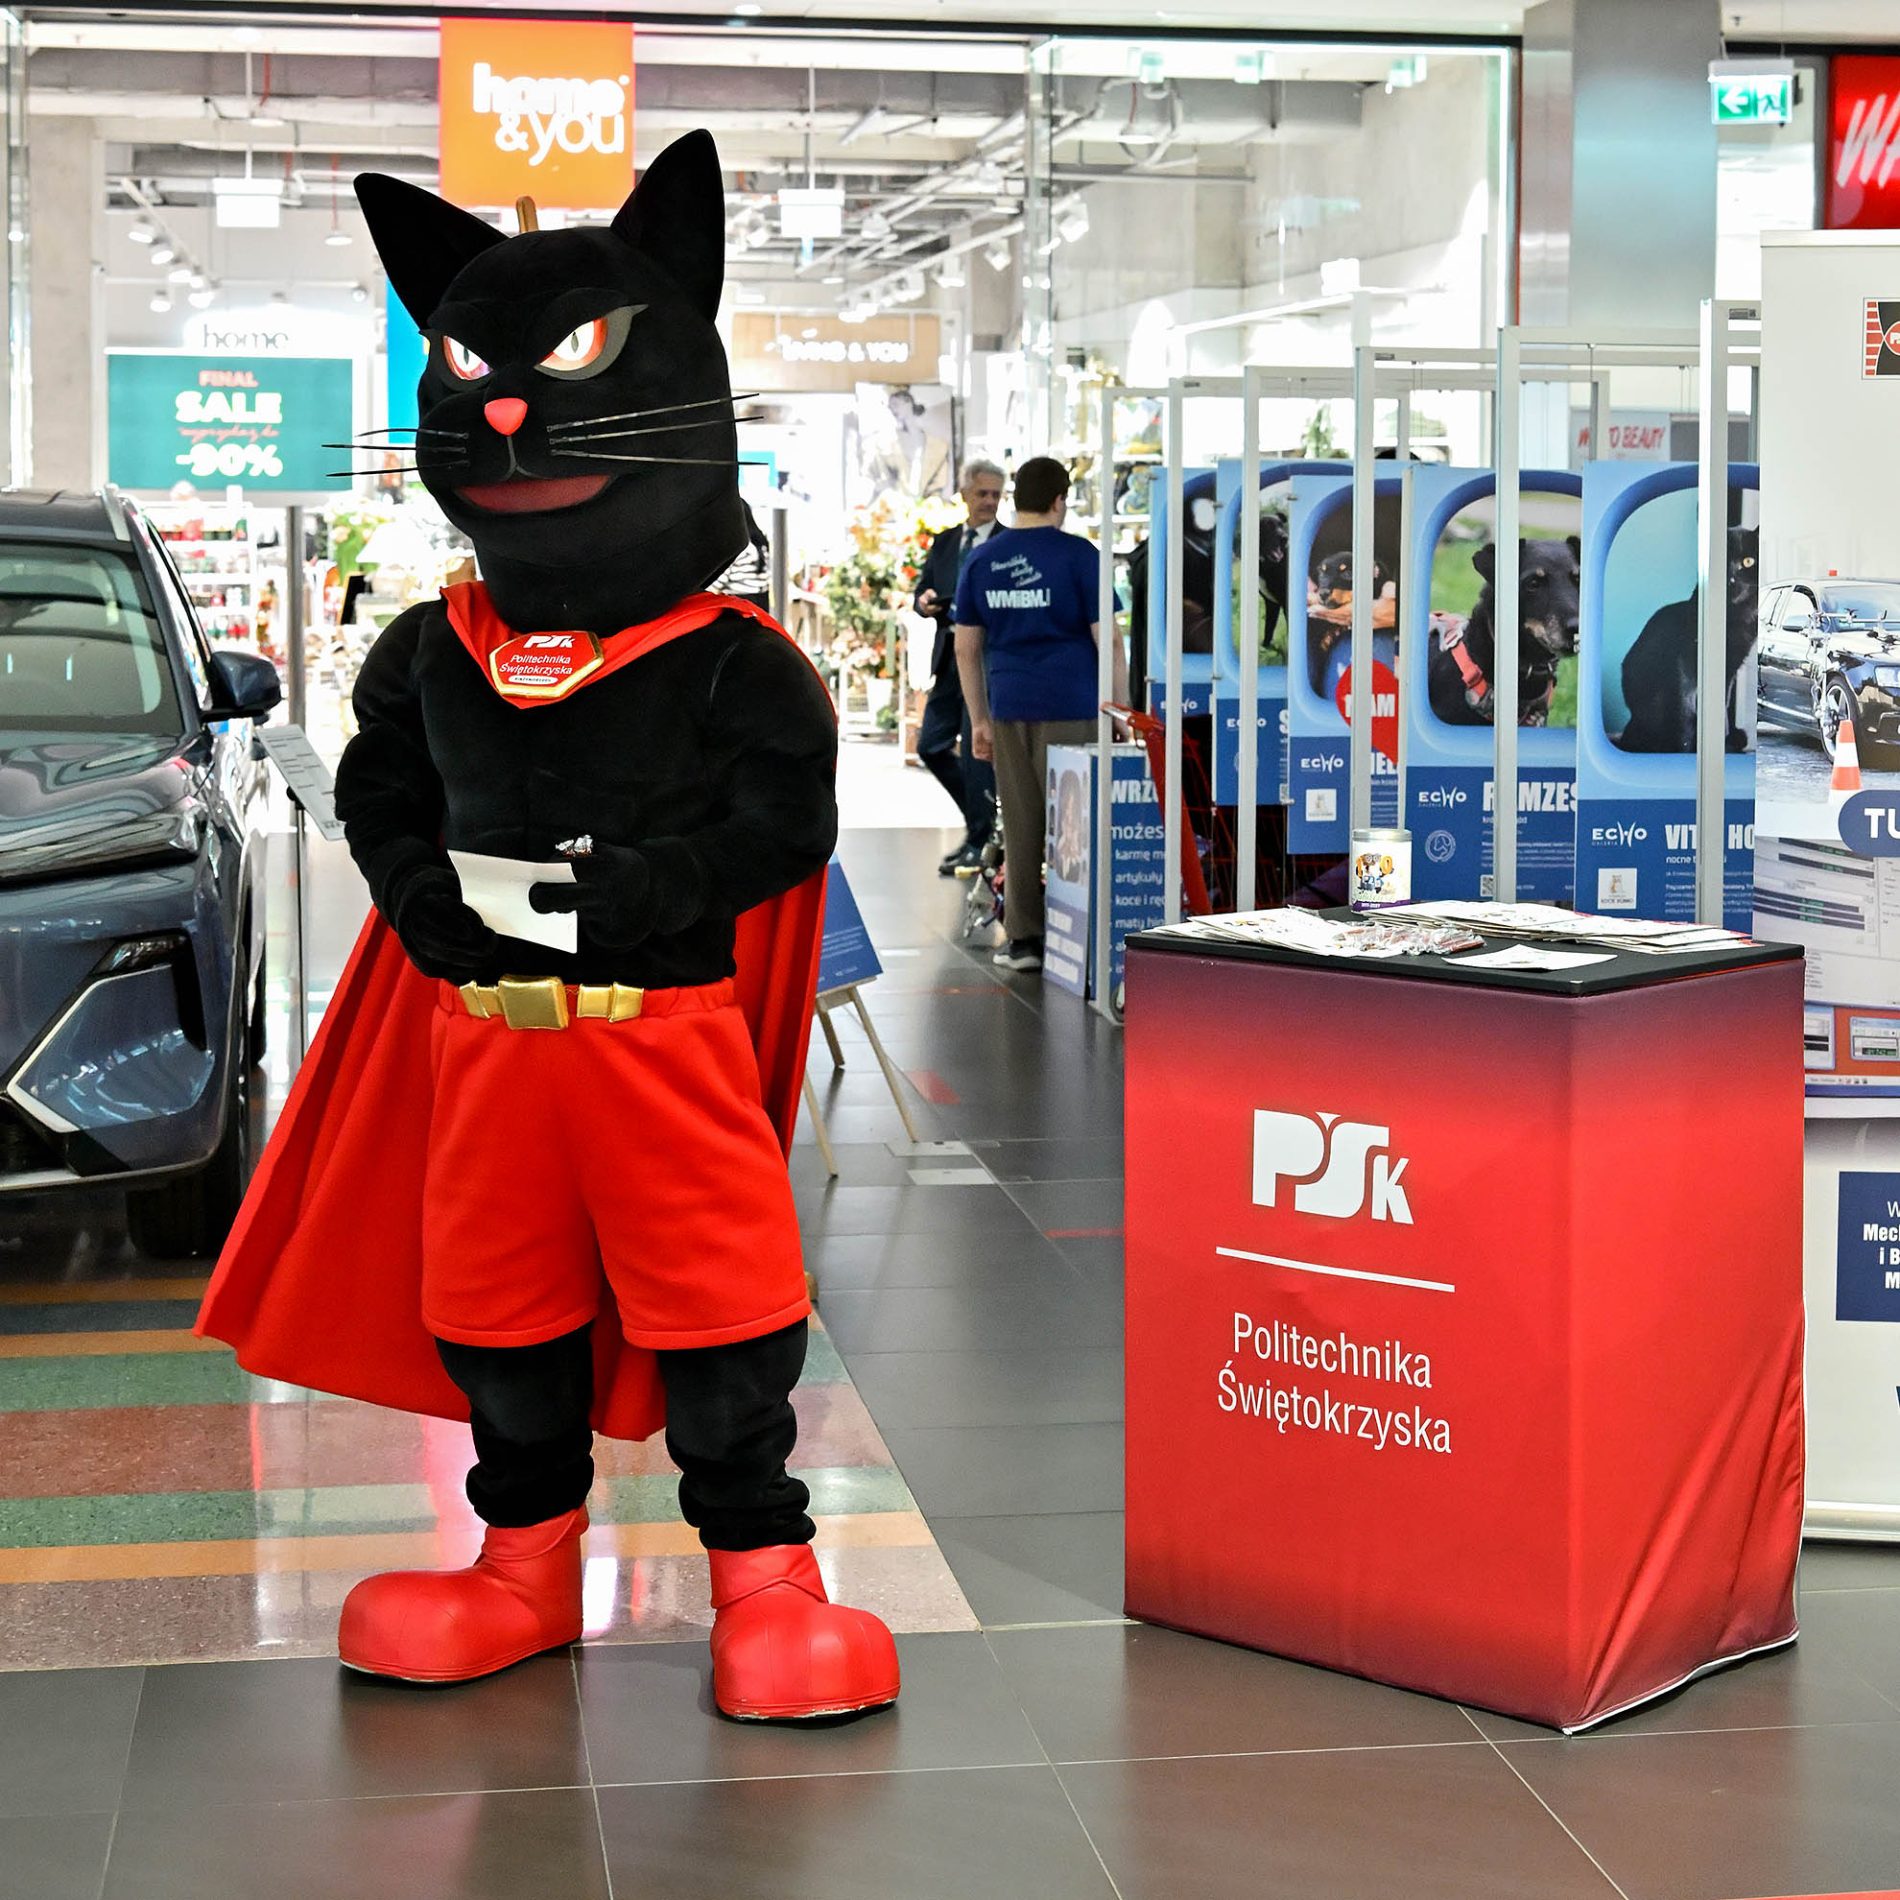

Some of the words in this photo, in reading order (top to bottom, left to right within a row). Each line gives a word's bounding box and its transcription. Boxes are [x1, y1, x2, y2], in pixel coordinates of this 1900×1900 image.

[176, 391, 283, 423] SALE
[176, 443, 284, 477] -90%
[499, 662, 573, 676] Świętokrzyska
[510, 654, 571, 664] Politechnika
[1301, 753, 1344, 774] ECHO
[1418, 785, 1467, 810] ECHO
[1592, 821, 1648, 848] ECHO
[1115, 871, 1164, 886] artykuły
[1115, 894, 1140, 906] koce
[1879, 1246, 1885, 1265] i
[1233, 1312, 1433, 1388] Politechnika
[1217, 1361, 1452, 1454] Świętokrzyska
